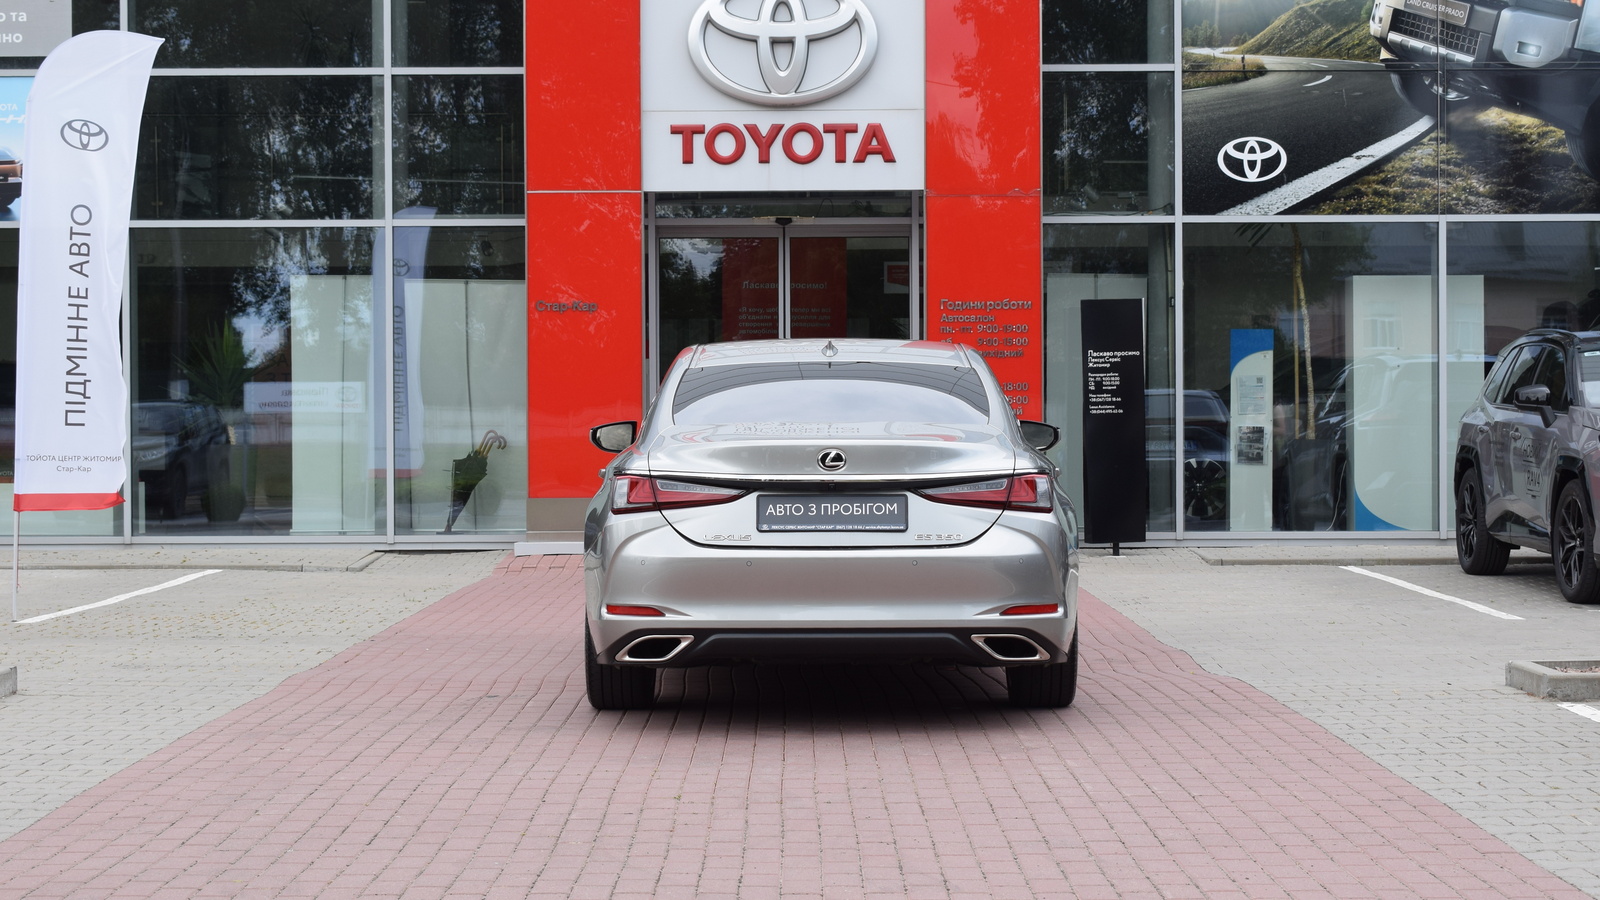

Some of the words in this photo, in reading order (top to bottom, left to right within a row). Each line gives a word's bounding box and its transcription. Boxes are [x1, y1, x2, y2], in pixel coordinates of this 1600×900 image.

[1422, 1, 1445, 12] CRUISER
[1445, 8, 1465, 18] PRADO
[10, 12, 27, 22] та
[670, 122, 897, 165] TOYOTA
[69, 204, 93, 278] АВТО
[791, 281, 827, 289] росимо!
[536, 300, 598, 313] Стар-Кар
[940, 299, 985, 311] Години
[987, 298, 1032, 312] роботи
[940, 314, 995, 323] Автосалон
[977, 324, 1029, 333] 9:00-19:00
[977, 338, 1029, 346] 9:00-15:00
[65, 286, 92, 427] ПІДМІННЕ
[26, 453, 57, 462] ТОЙОТА
[58, 455, 81, 463] ЦЕНТР
[56, 465, 92, 473] Стар-Кар
[1527, 470, 1540, 487] RAV4
[765, 504, 804, 516] АВТО
[808, 503, 817, 516] З
[821, 503, 898, 516] ПРОБІГОМ
[914, 533, 933, 541] ES
[935, 533, 963, 541] 350
